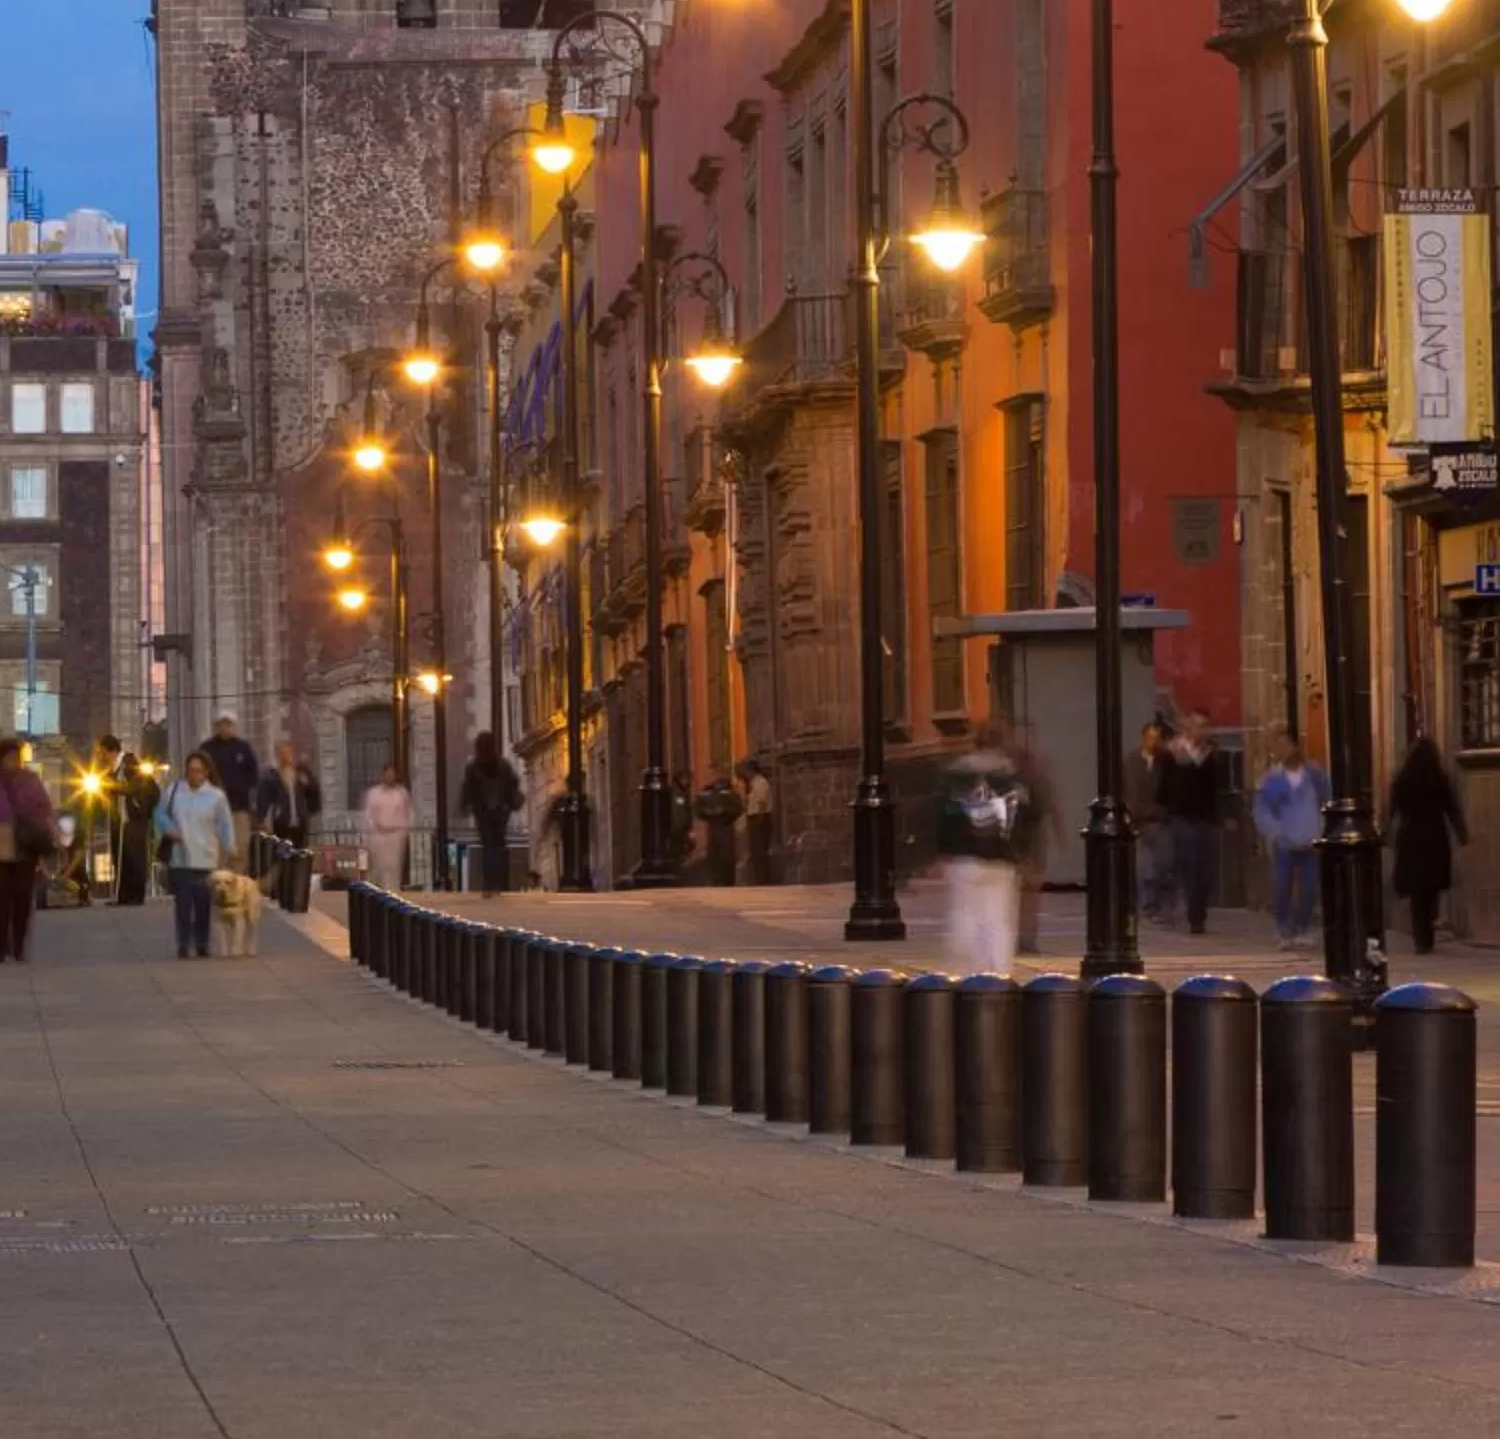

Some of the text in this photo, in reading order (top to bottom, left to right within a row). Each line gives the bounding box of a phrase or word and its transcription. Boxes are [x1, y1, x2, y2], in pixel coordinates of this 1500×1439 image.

[1398, 188, 1474, 202] TERRAZA
[1415, 230, 1449, 418] EL ANTOJO
